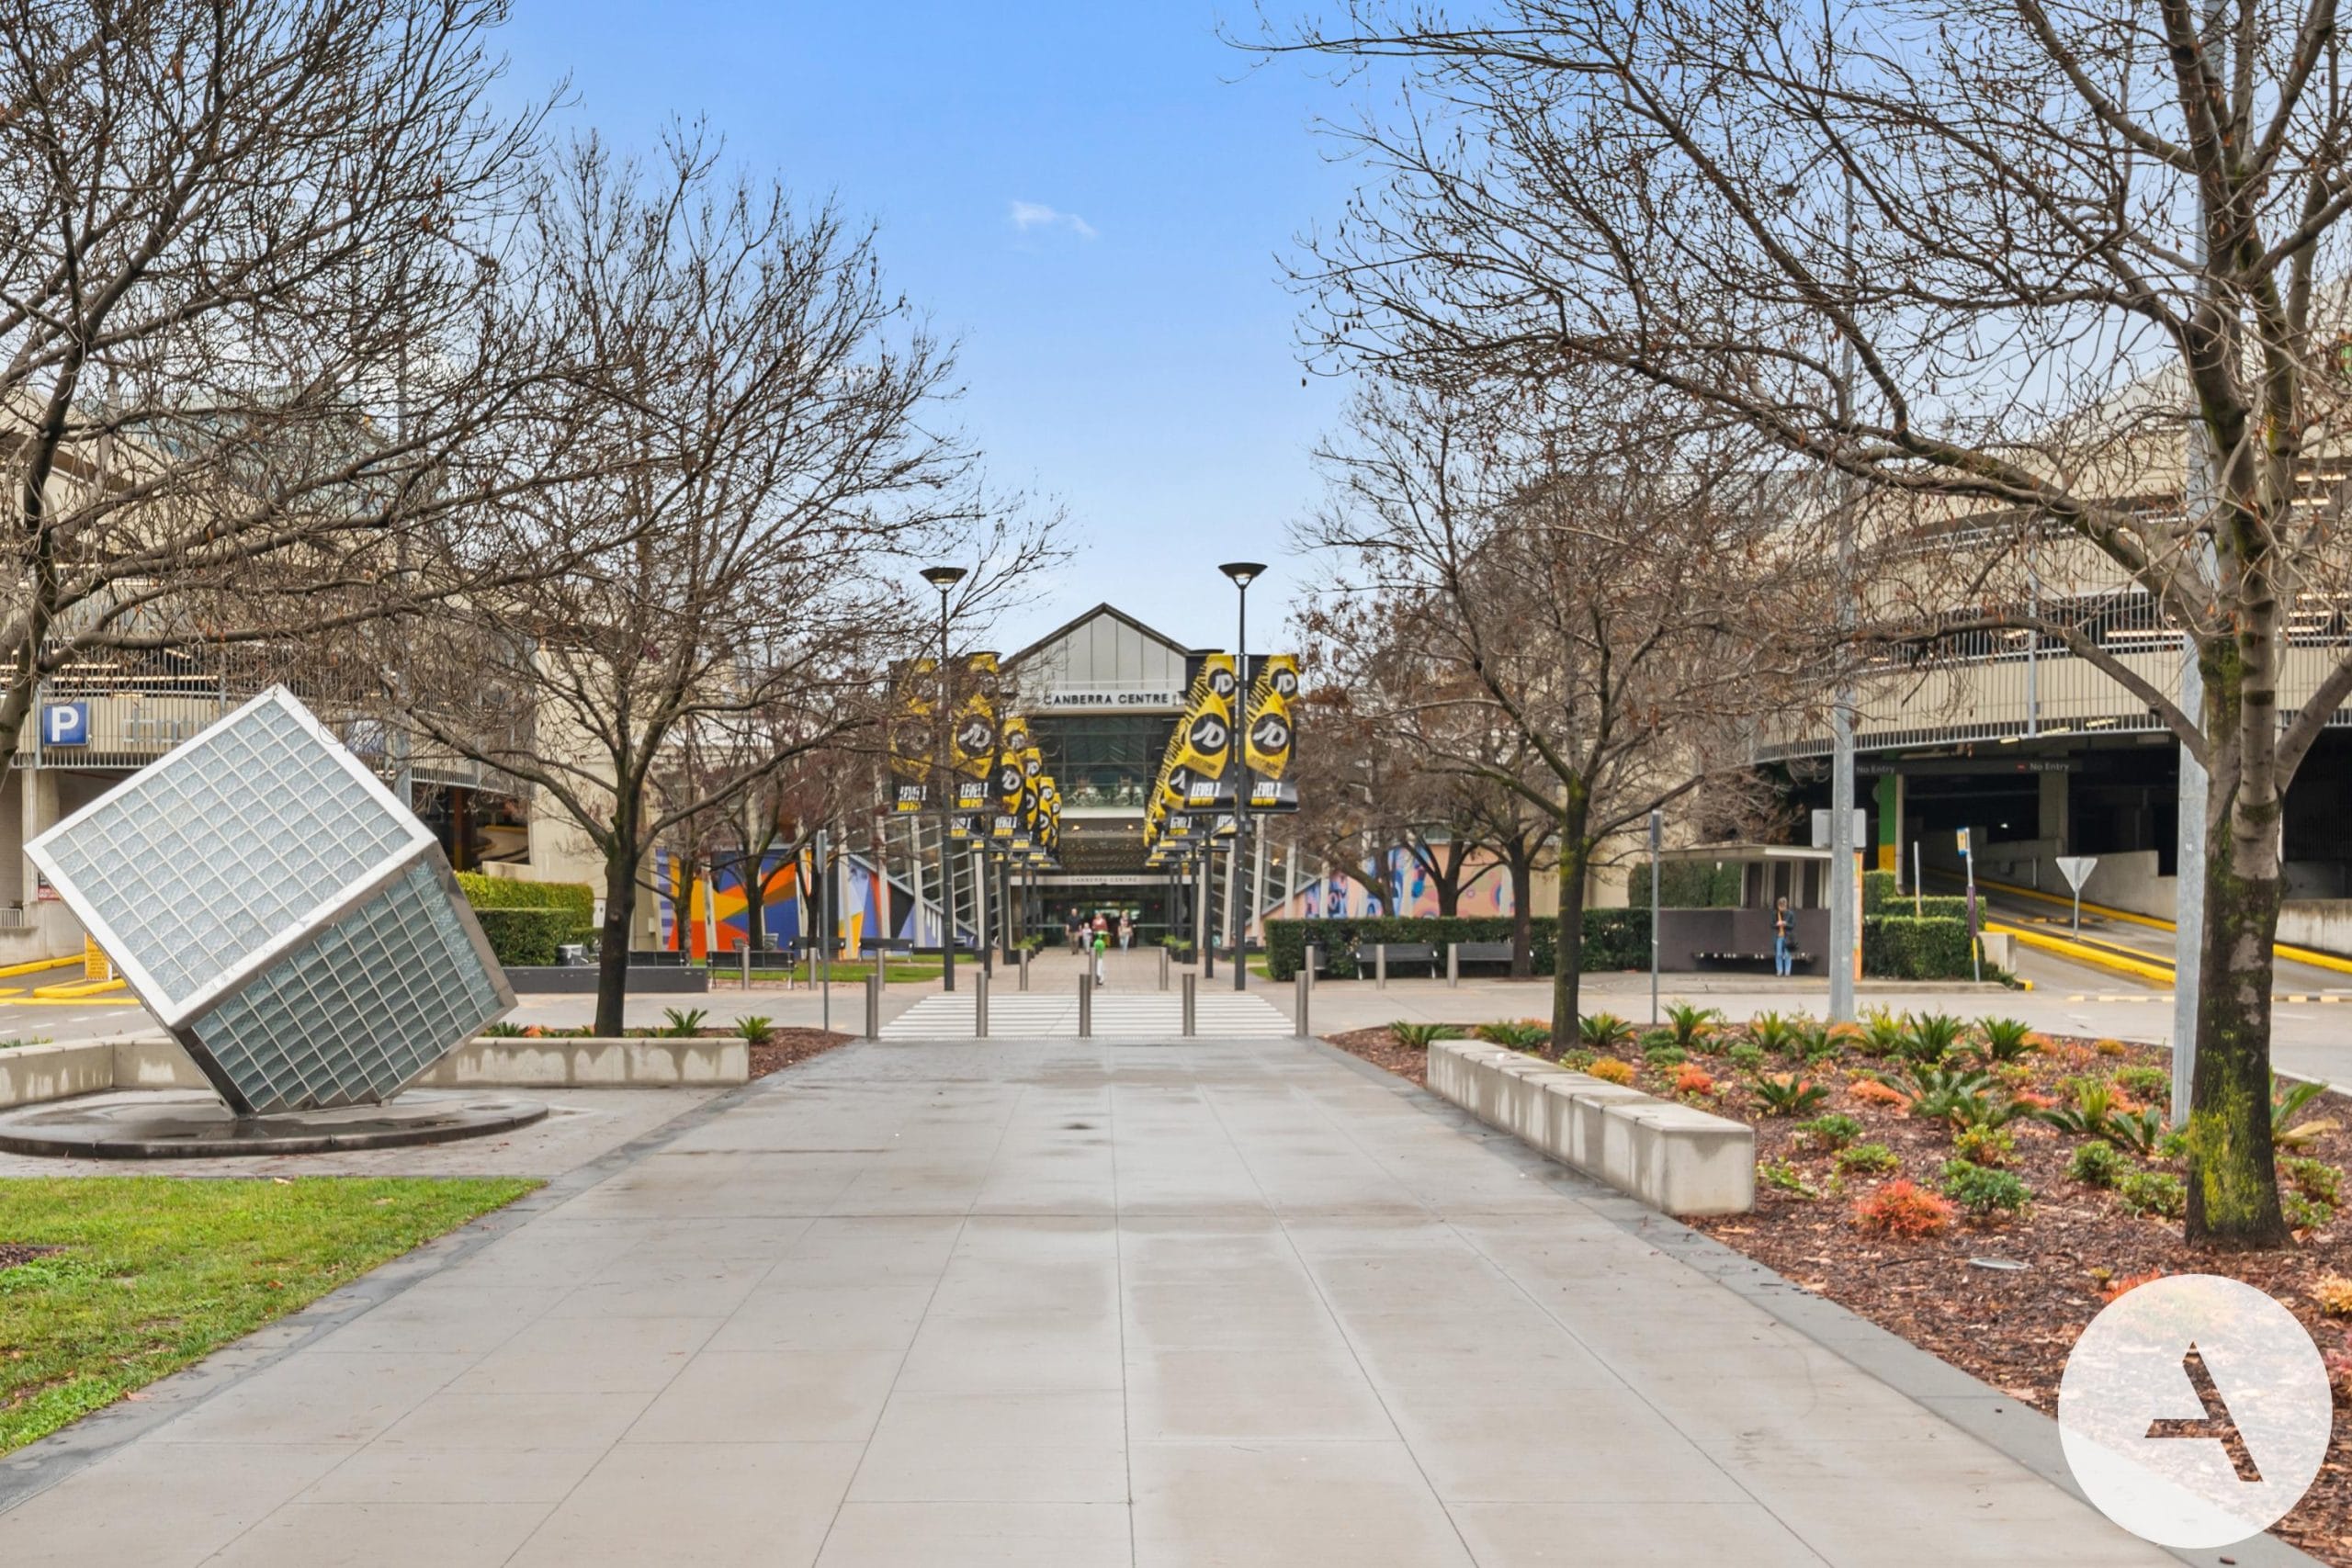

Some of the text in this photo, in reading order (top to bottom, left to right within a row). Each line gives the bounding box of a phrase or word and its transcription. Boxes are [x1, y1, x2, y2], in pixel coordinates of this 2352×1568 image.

[1044, 694, 1169, 705] CANBERRA CENTRE
[51, 705, 79, 742] P
[1191, 721, 1227, 749] JD
[1252, 721, 1288, 749] JD
[1871, 765, 1895, 774] Entry
[2030, 762, 2070, 773] No Entry
[1191, 782, 1215, 797] LEVEL
